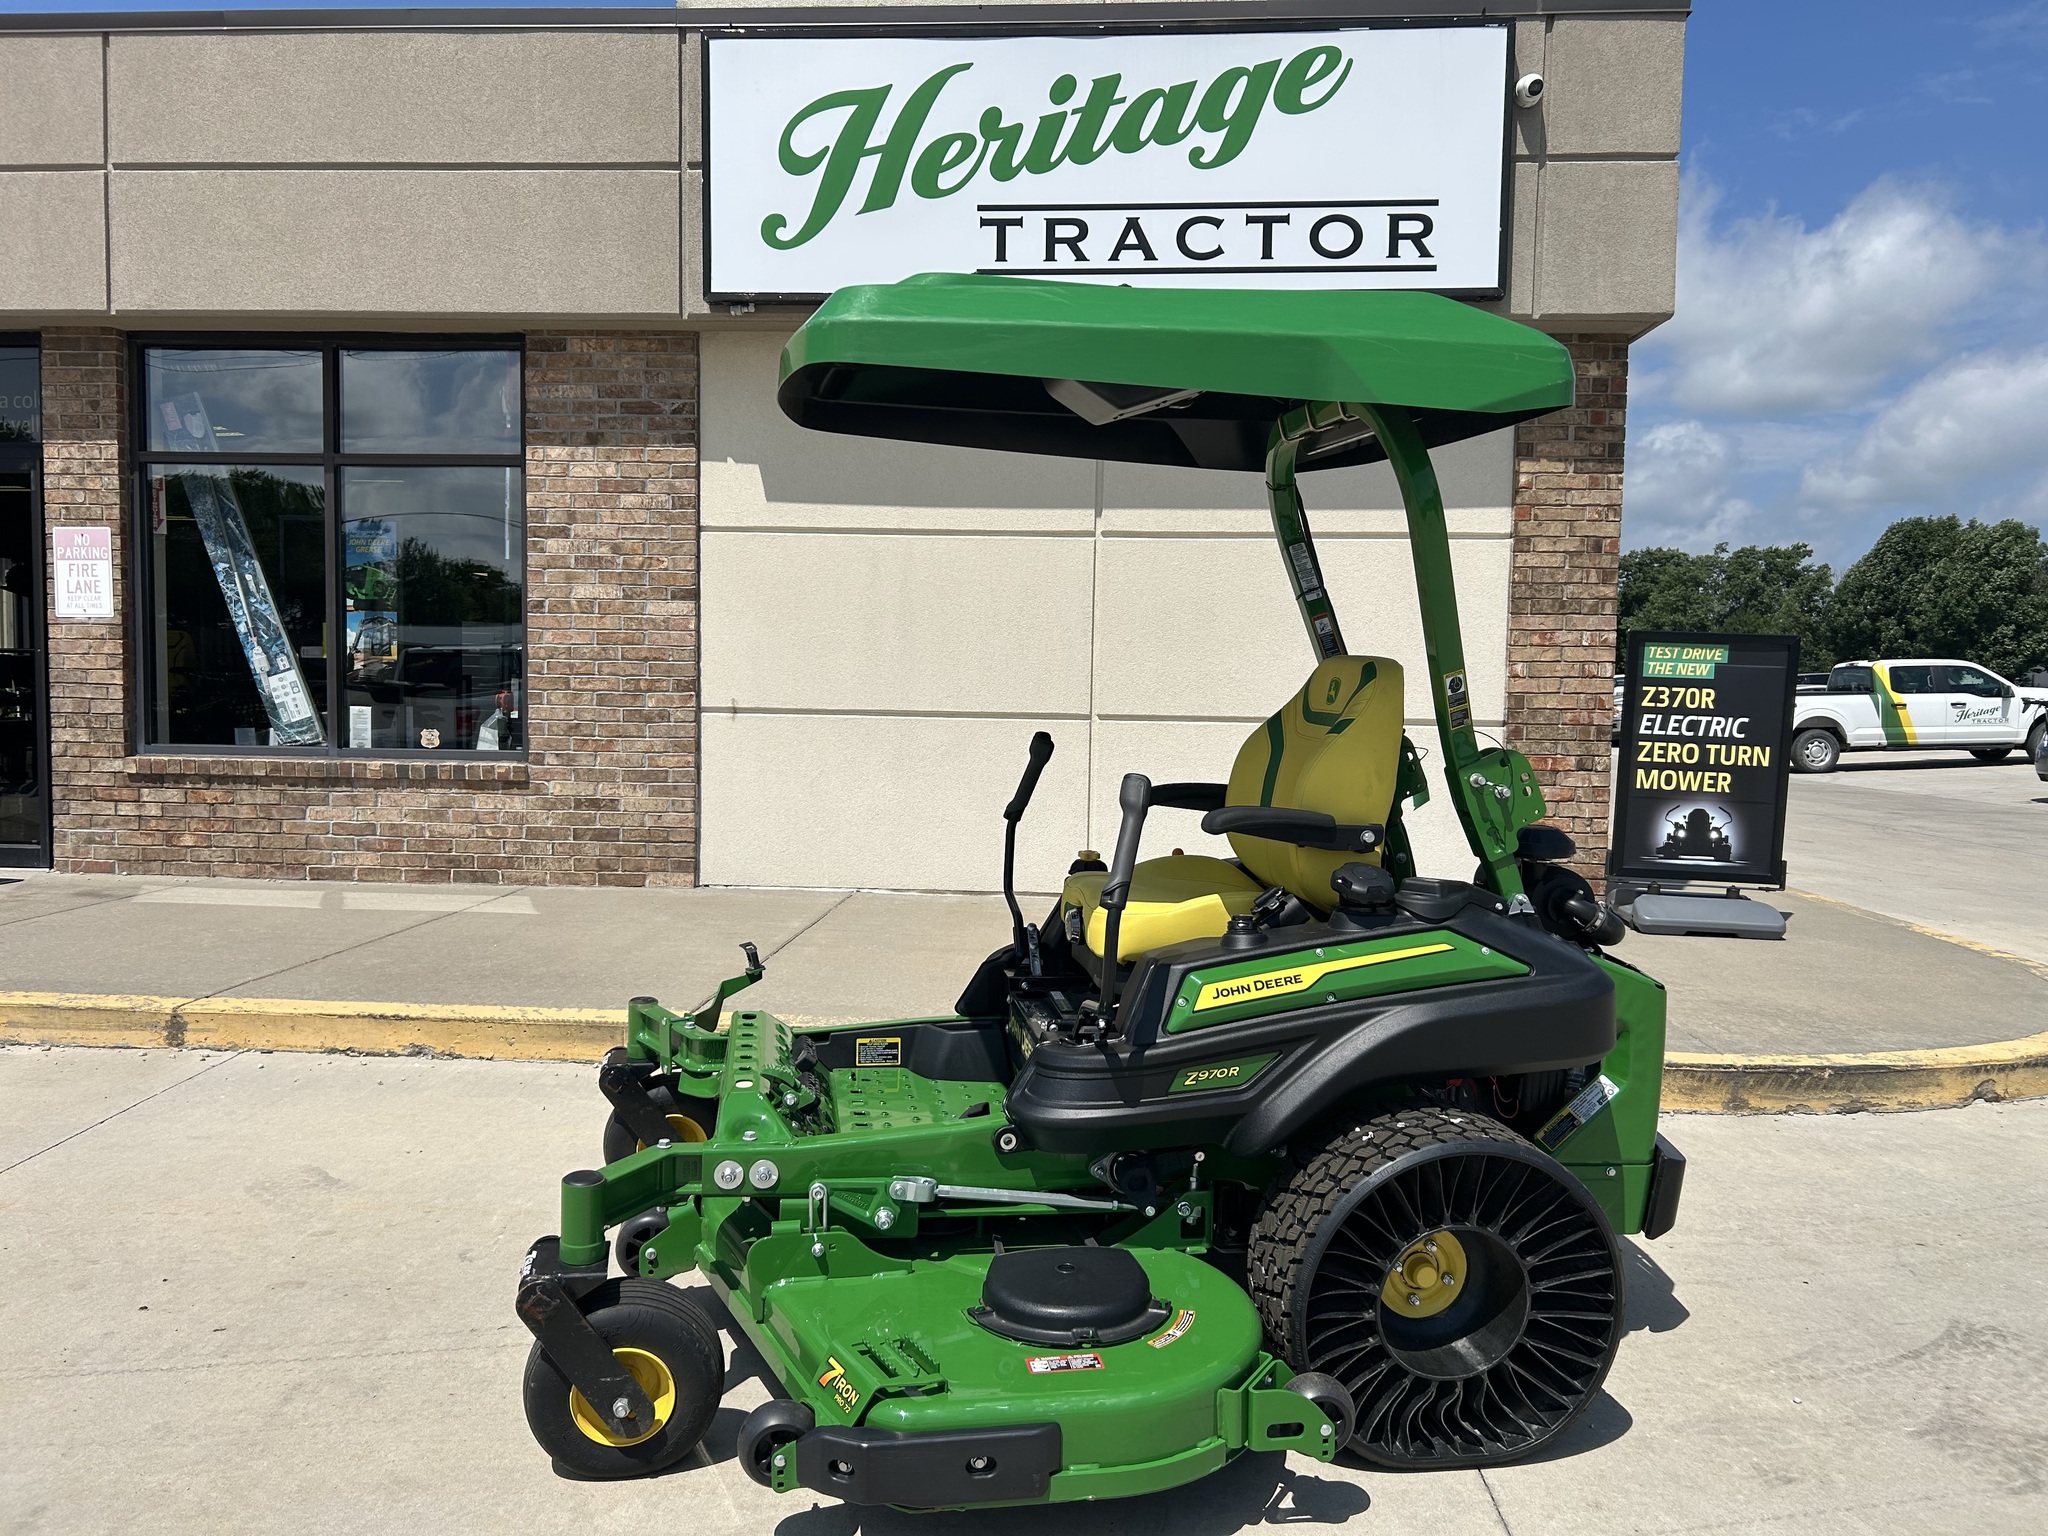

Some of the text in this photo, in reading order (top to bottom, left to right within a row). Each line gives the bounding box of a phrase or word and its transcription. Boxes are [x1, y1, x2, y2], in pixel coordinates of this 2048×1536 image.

[761, 45, 1353, 249] Heritage
[979, 212, 1436, 262] TRACTOR
[74, 533, 90, 546] NO
[349, 538, 390, 546] JOHN DEERE
[57, 546, 108, 559] PARKING
[68, 563, 98, 578] FIRE
[66, 580, 102, 594] LANE
[1649, 646, 1724, 661] TEST DRIVE
[1648, 662, 1710, 676] THE NEW
[1641, 686, 1716, 709] Z370R
[1954, 705, 2001, 723] Heritage
[1638, 713, 1749, 739] ELECTRIC
[1637, 741, 1771, 767] ZERO TURN
[1635, 768, 1732, 793] MOWER
[1212, 974, 1303, 1000] JOHN DEERE
[1184, 1066, 1240, 1085] Z970R
[833, 1393, 851, 1414] PRO 72
